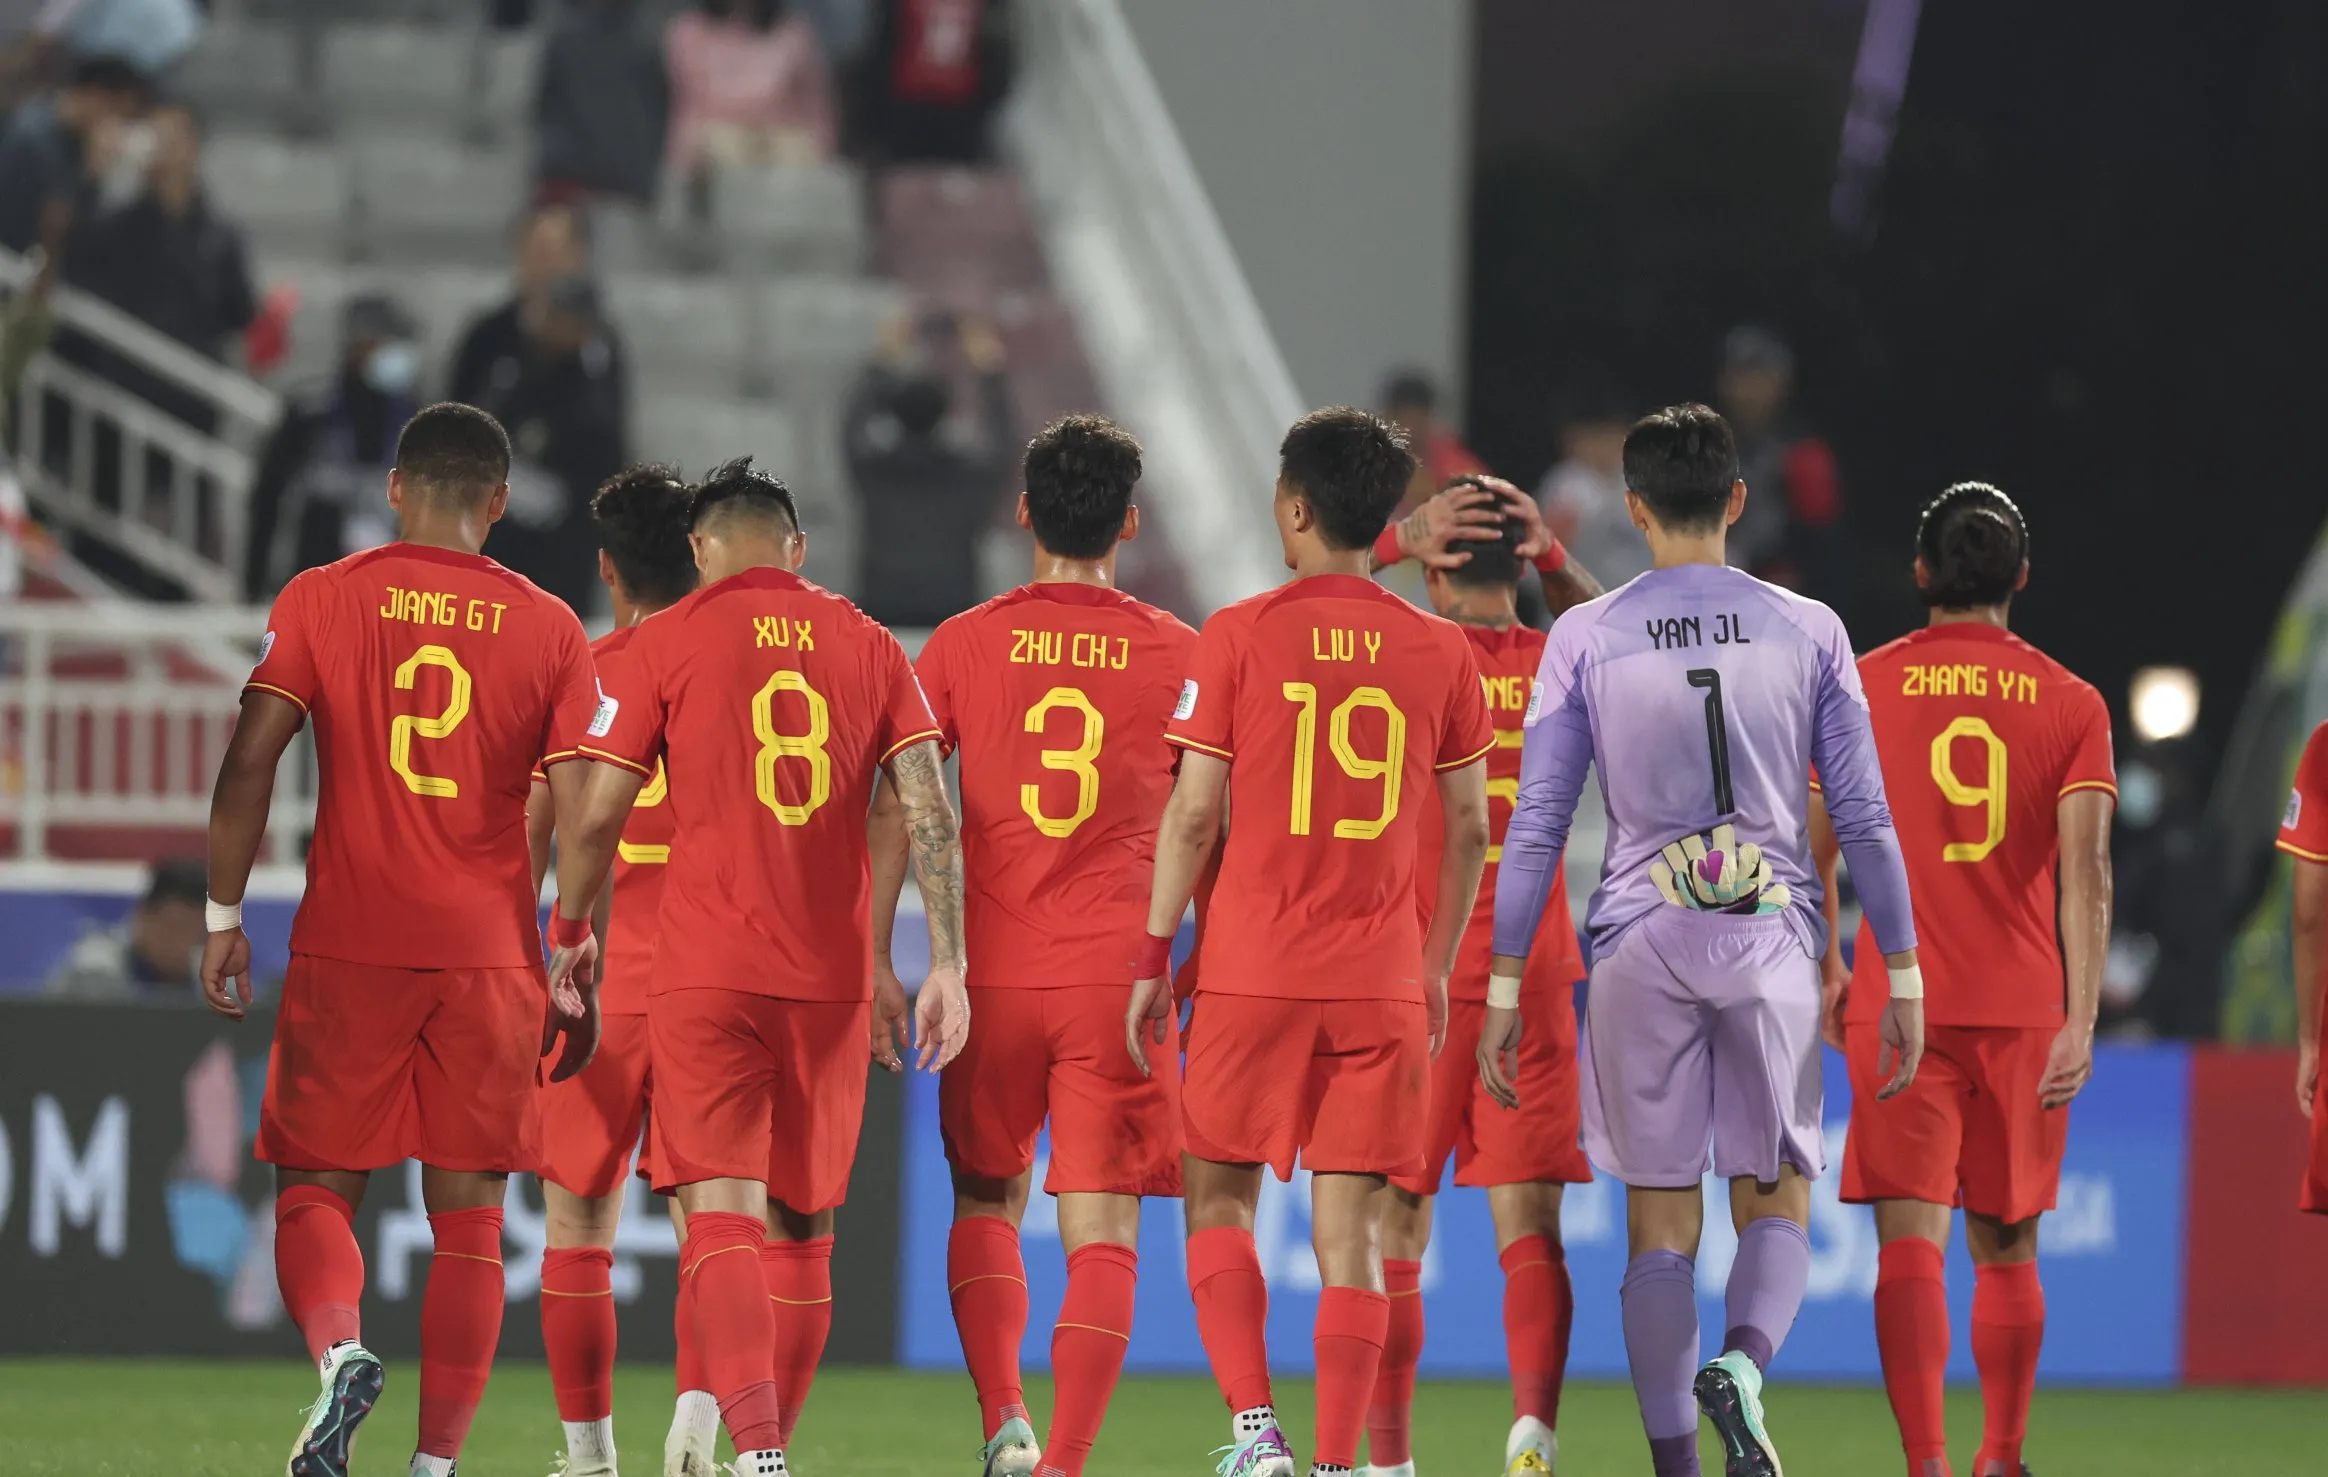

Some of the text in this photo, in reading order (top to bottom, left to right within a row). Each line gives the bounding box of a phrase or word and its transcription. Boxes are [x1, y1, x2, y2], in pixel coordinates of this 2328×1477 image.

[380, 586, 458, 626] JIANG
[752, 615, 815, 651] XU X
[1009, 629, 1063, 665] ZHU
[1312, 627, 1381, 664] LIU Y
[1646, 613, 1751, 650] YAN JL
[389, 644, 472, 799] 2
[1902, 664, 2037, 705] ZHANG YN
[751, 669, 831, 826] 8
[1020, 686, 1105, 838] 3
[1282, 681, 1406, 840] 19
[1686, 668, 1736, 817] 1
[1930, 716, 2008, 862] 9
